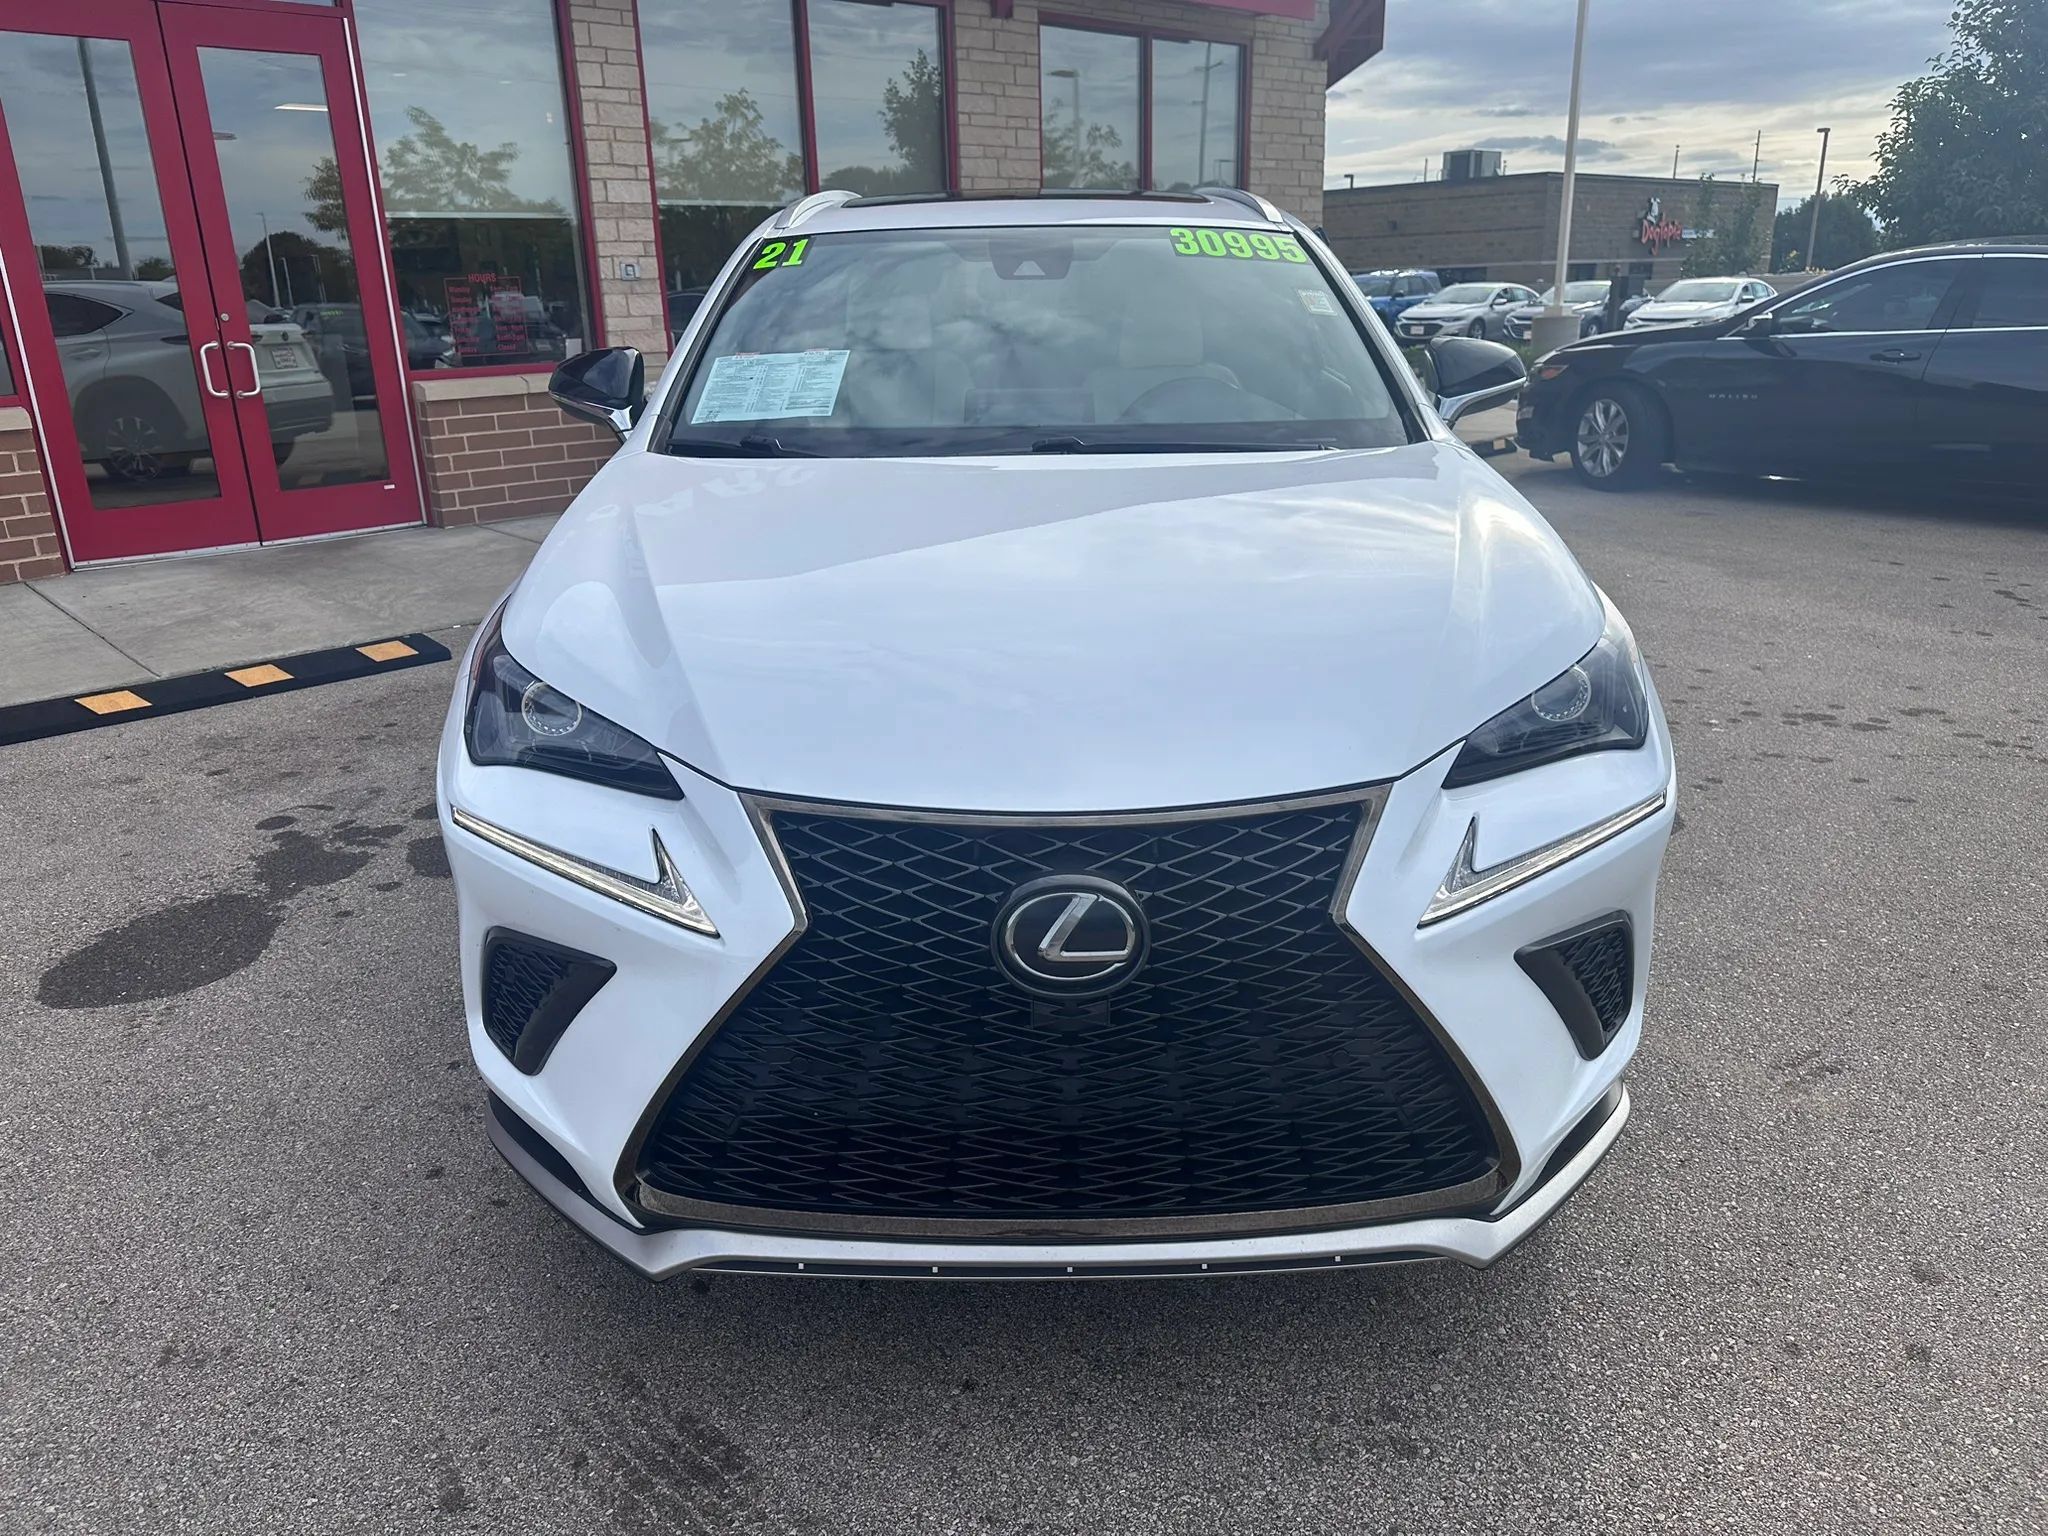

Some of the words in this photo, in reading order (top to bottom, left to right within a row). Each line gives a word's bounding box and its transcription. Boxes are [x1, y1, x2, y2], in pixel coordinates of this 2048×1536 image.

[753, 239, 808, 269] 21
[1170, 228, 1307, 263] 30995
[467, 273, 497, 283] HOURS
